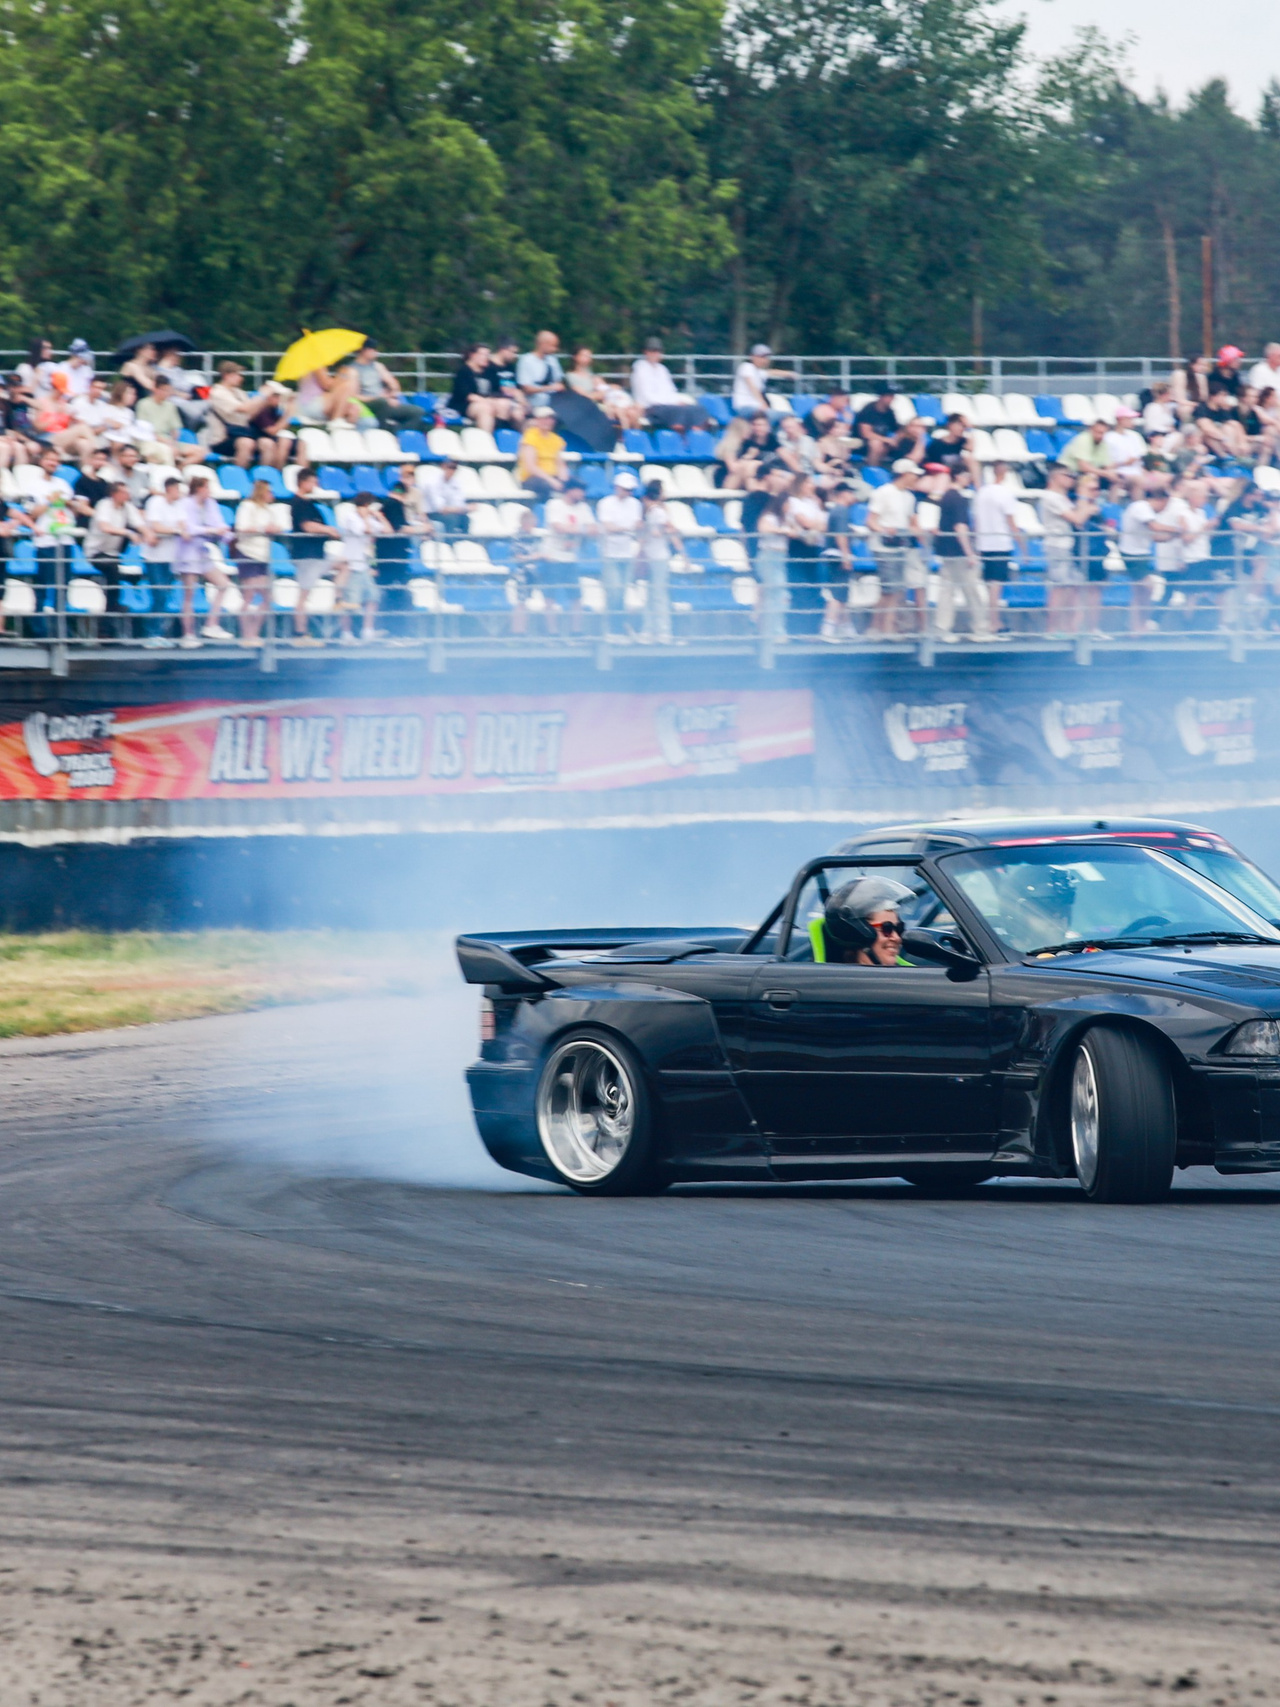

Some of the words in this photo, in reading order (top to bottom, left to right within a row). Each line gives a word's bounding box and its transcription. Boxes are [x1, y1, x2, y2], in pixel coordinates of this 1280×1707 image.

[210, 716, 270, 783] ALL
[281, 716, 335, 782] WE
[341, 713, 424, 782] NEED
[430, 711, 467, 780] IS
[473, 711, 568, 778] DRIFT
